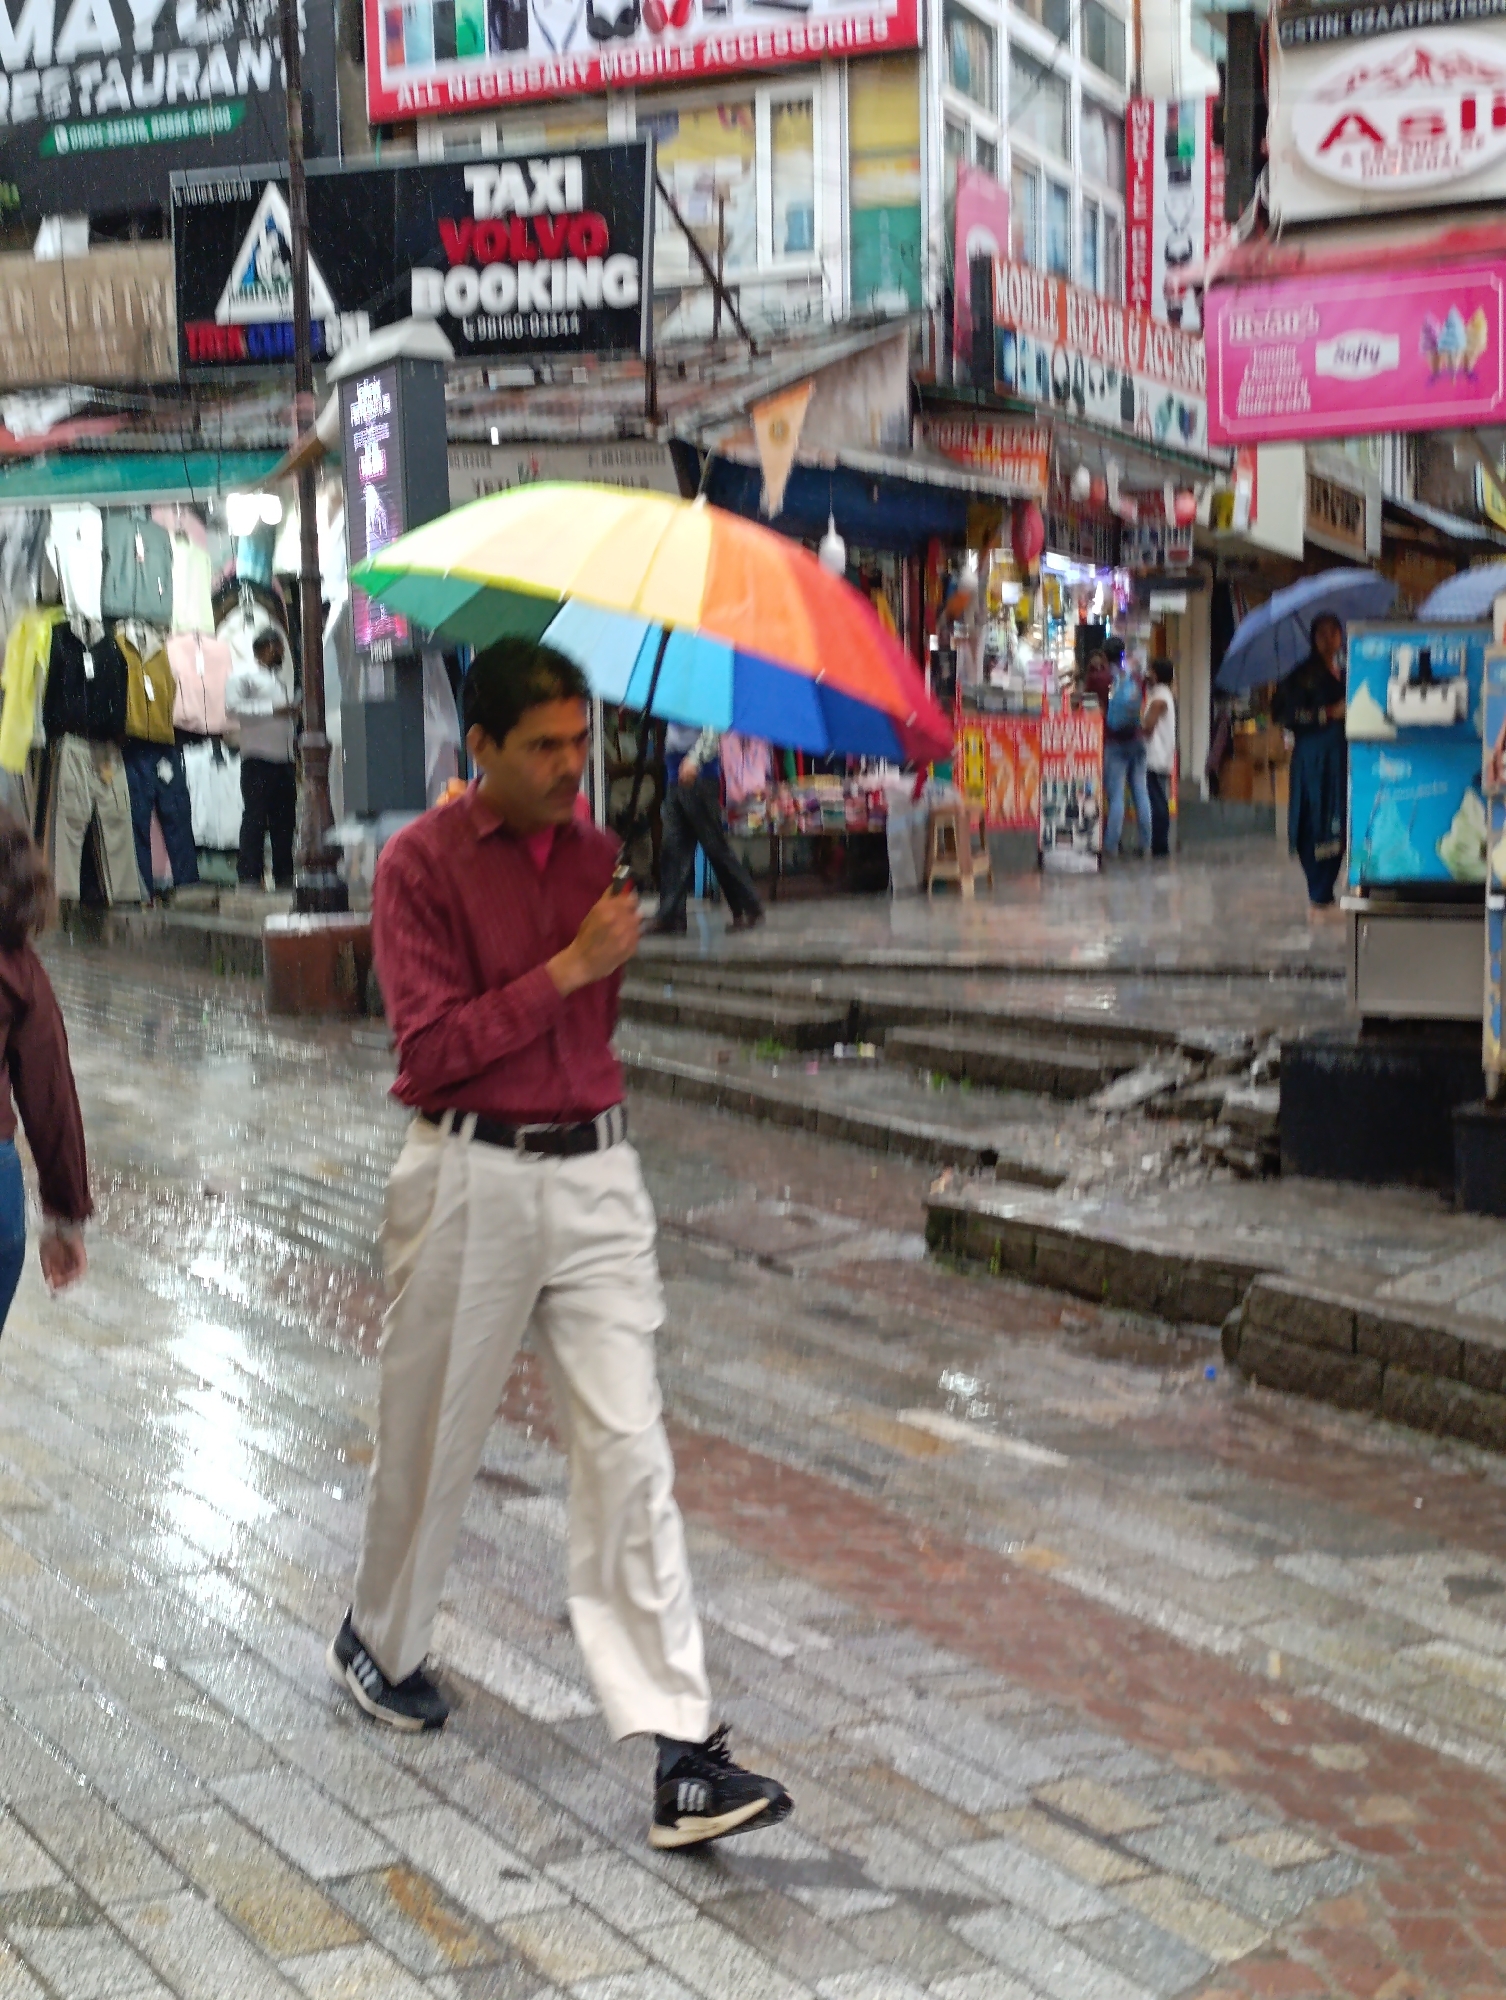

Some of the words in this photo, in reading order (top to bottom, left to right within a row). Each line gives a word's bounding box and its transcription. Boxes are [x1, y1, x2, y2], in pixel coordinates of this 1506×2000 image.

[397, 75, 442, 111] ALL
[447, 56, 592, 103] NECESSARY
[600, 36, 696, 81] MOBILE
[704, 13, 889, 67] ACCESSORIES
[463, 156, 584, 220] TAXI
[437, 210, 609, 266] VOLVO
[411, 253, 639, 320] BOOKING
[994, 259, 1059, 335] MOBILE
[1066, 285, 1125, 363] REPAIR
